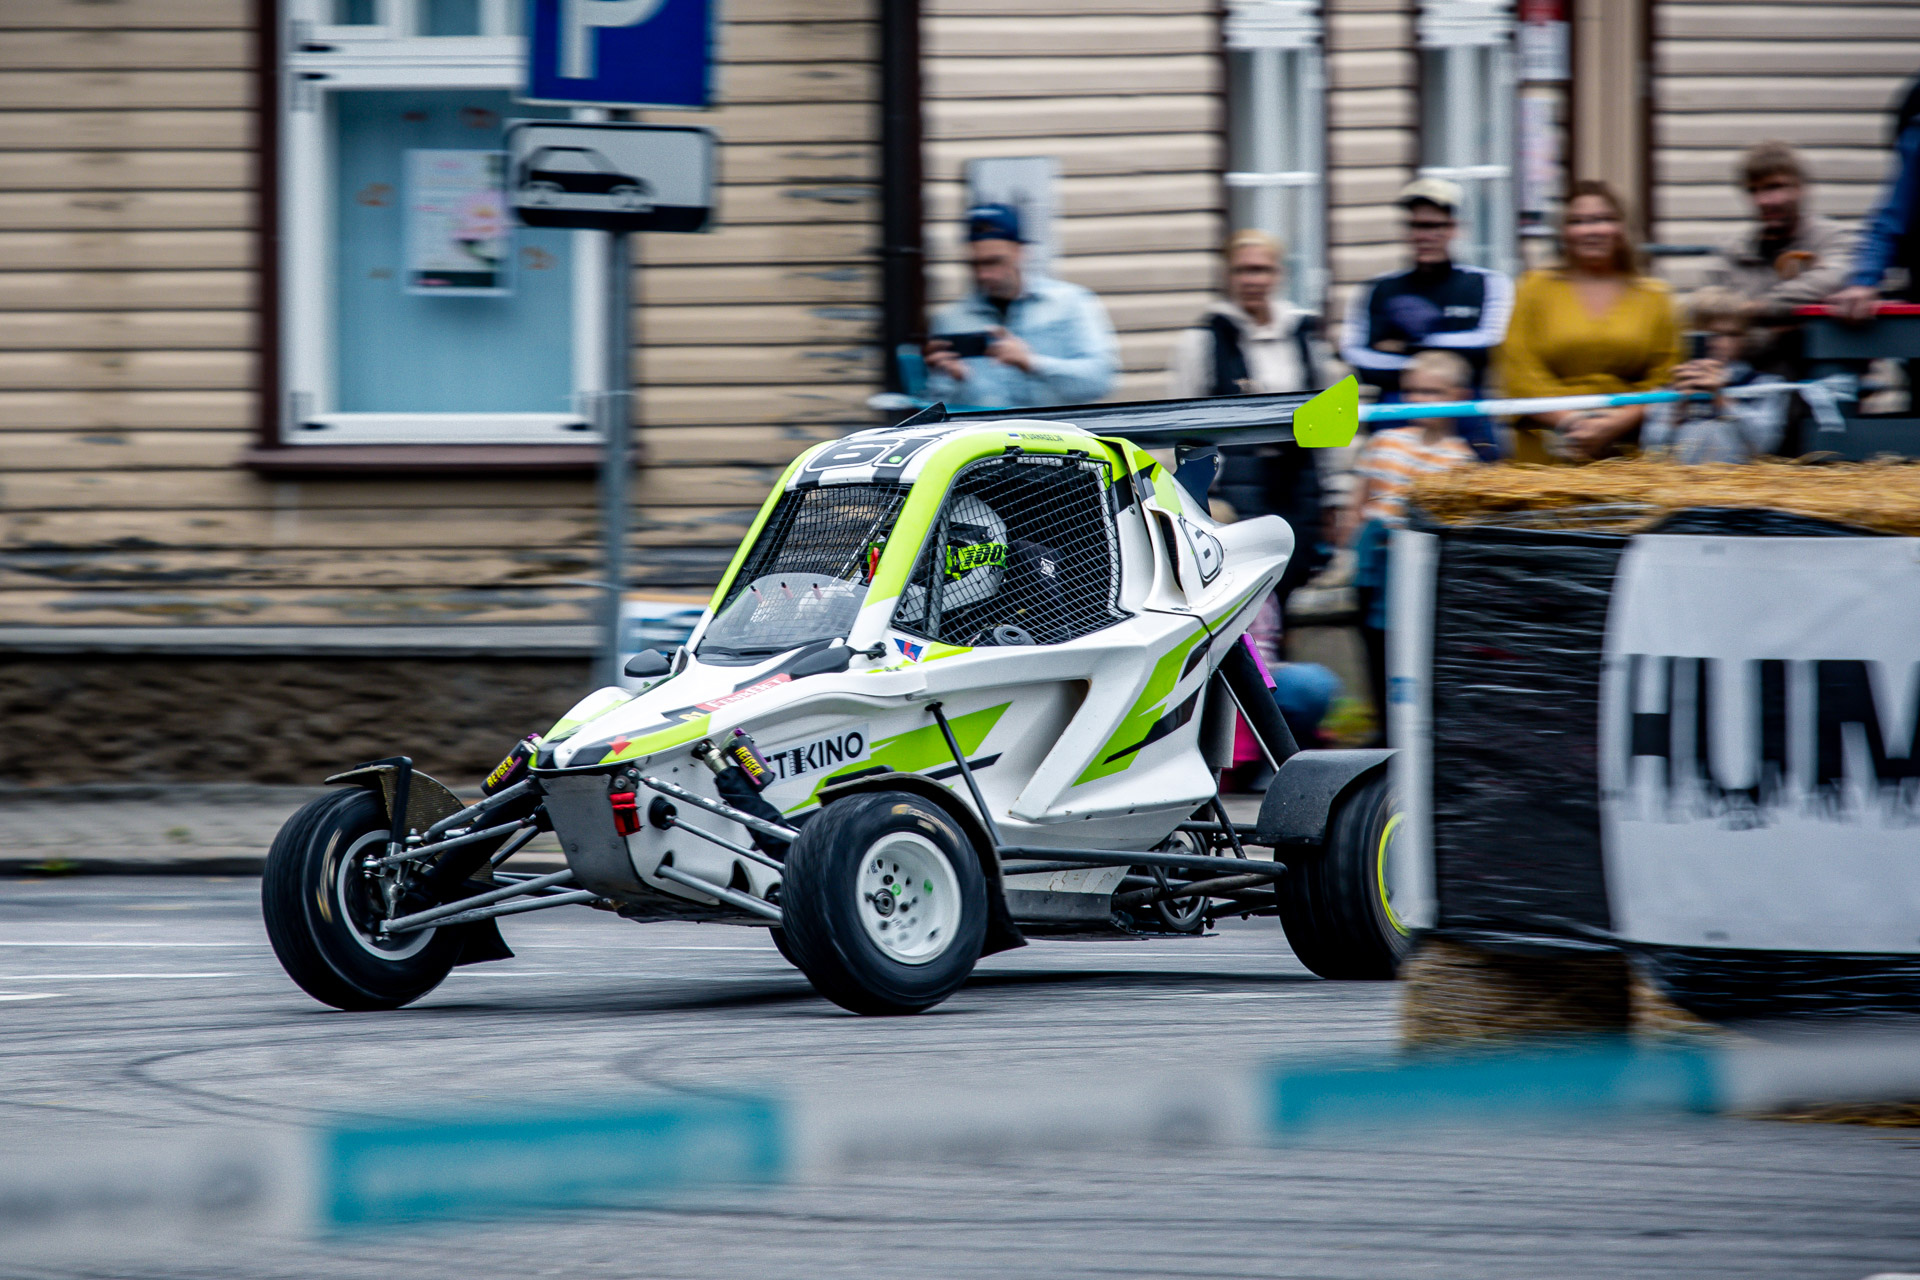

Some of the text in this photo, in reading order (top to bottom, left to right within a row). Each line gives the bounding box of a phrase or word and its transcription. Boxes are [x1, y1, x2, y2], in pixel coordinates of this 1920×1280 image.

[557, 0, 668, 80] P
[486, 755, 515, 788] REIGER
[735, 745, 765, 777] REIGER
